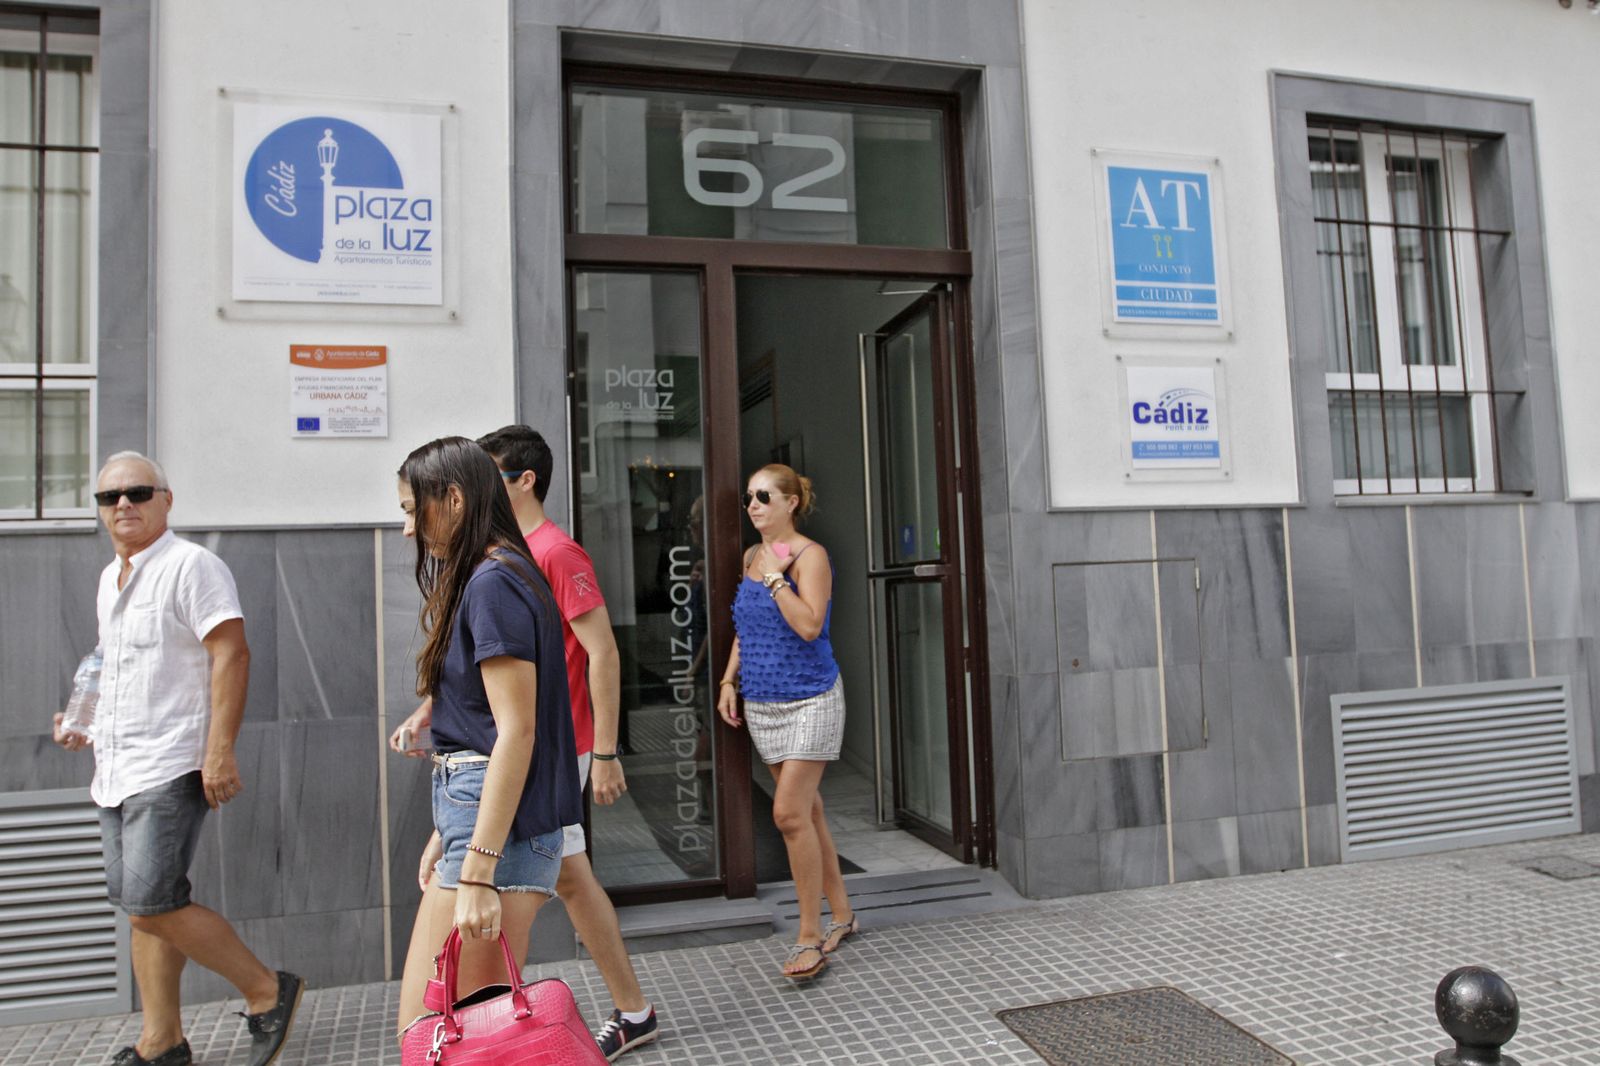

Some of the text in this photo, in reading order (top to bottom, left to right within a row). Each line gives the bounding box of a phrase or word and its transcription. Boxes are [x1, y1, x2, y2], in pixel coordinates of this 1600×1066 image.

[682, 127, 848, 213] 62
[264, 160, 298, 218] Cádiz
[334, 190, 432, 225] plaza
[1119, 176, 1202, 232] AT
[335, 222, 432, 252] de la luz
[334, 254, 432, 267] Apartamentos Turísticos
[1138, 263, 1191, 275] CONJUNTO
[1140, 287, 1193, 302] CIUDAD
[605, 364, 674, 393] plaza
[309, 391, 368, 401] URBANA CÁDIZ
[606, 388, 674, 410] de la luz
[1132, 401, 1209, 424] Cádiz
[668, 544, 706, 853] plazadelaluz.com
